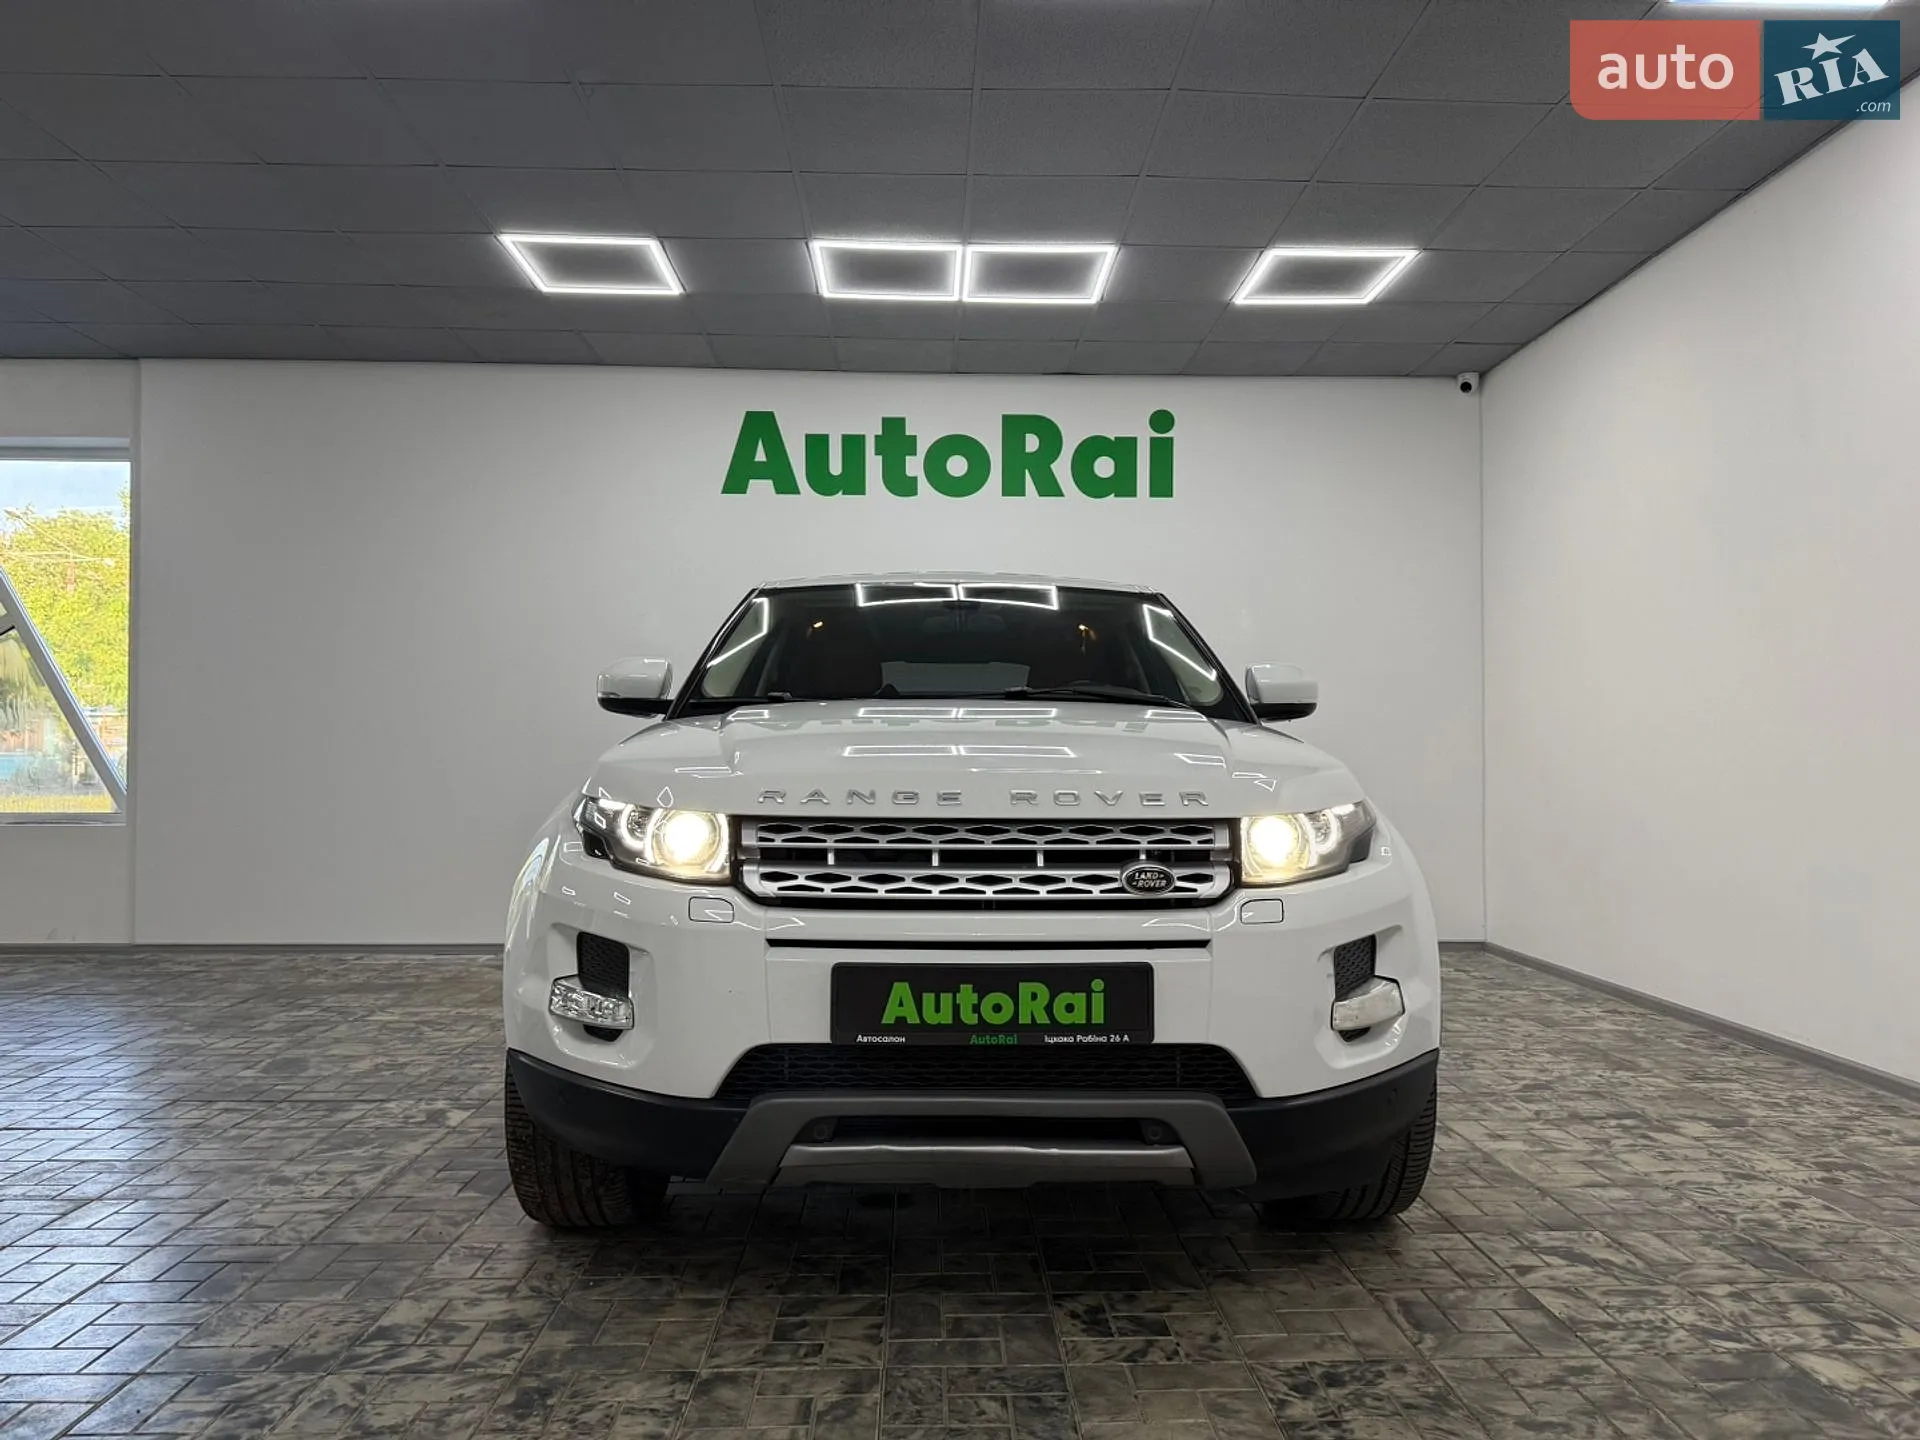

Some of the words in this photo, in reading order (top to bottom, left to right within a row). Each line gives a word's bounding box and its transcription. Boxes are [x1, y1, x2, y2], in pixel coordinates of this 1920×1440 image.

[720, 408, 1176, 499] AutoRai
[757, 789, 964, 806] RANGE
[1009, 789, 1209, 807] ROVER
[1134, 871, 1159, 880] LAND
[1137, 879, 1167, 888] ROVER
[881, 978, 1105, 1025] AutoRai
[856, 1034, 906, 1044] Автосалон
[970, 1034, 1018, 1045] AutoRai
[1109, 1034, 1121, 1043] 26
